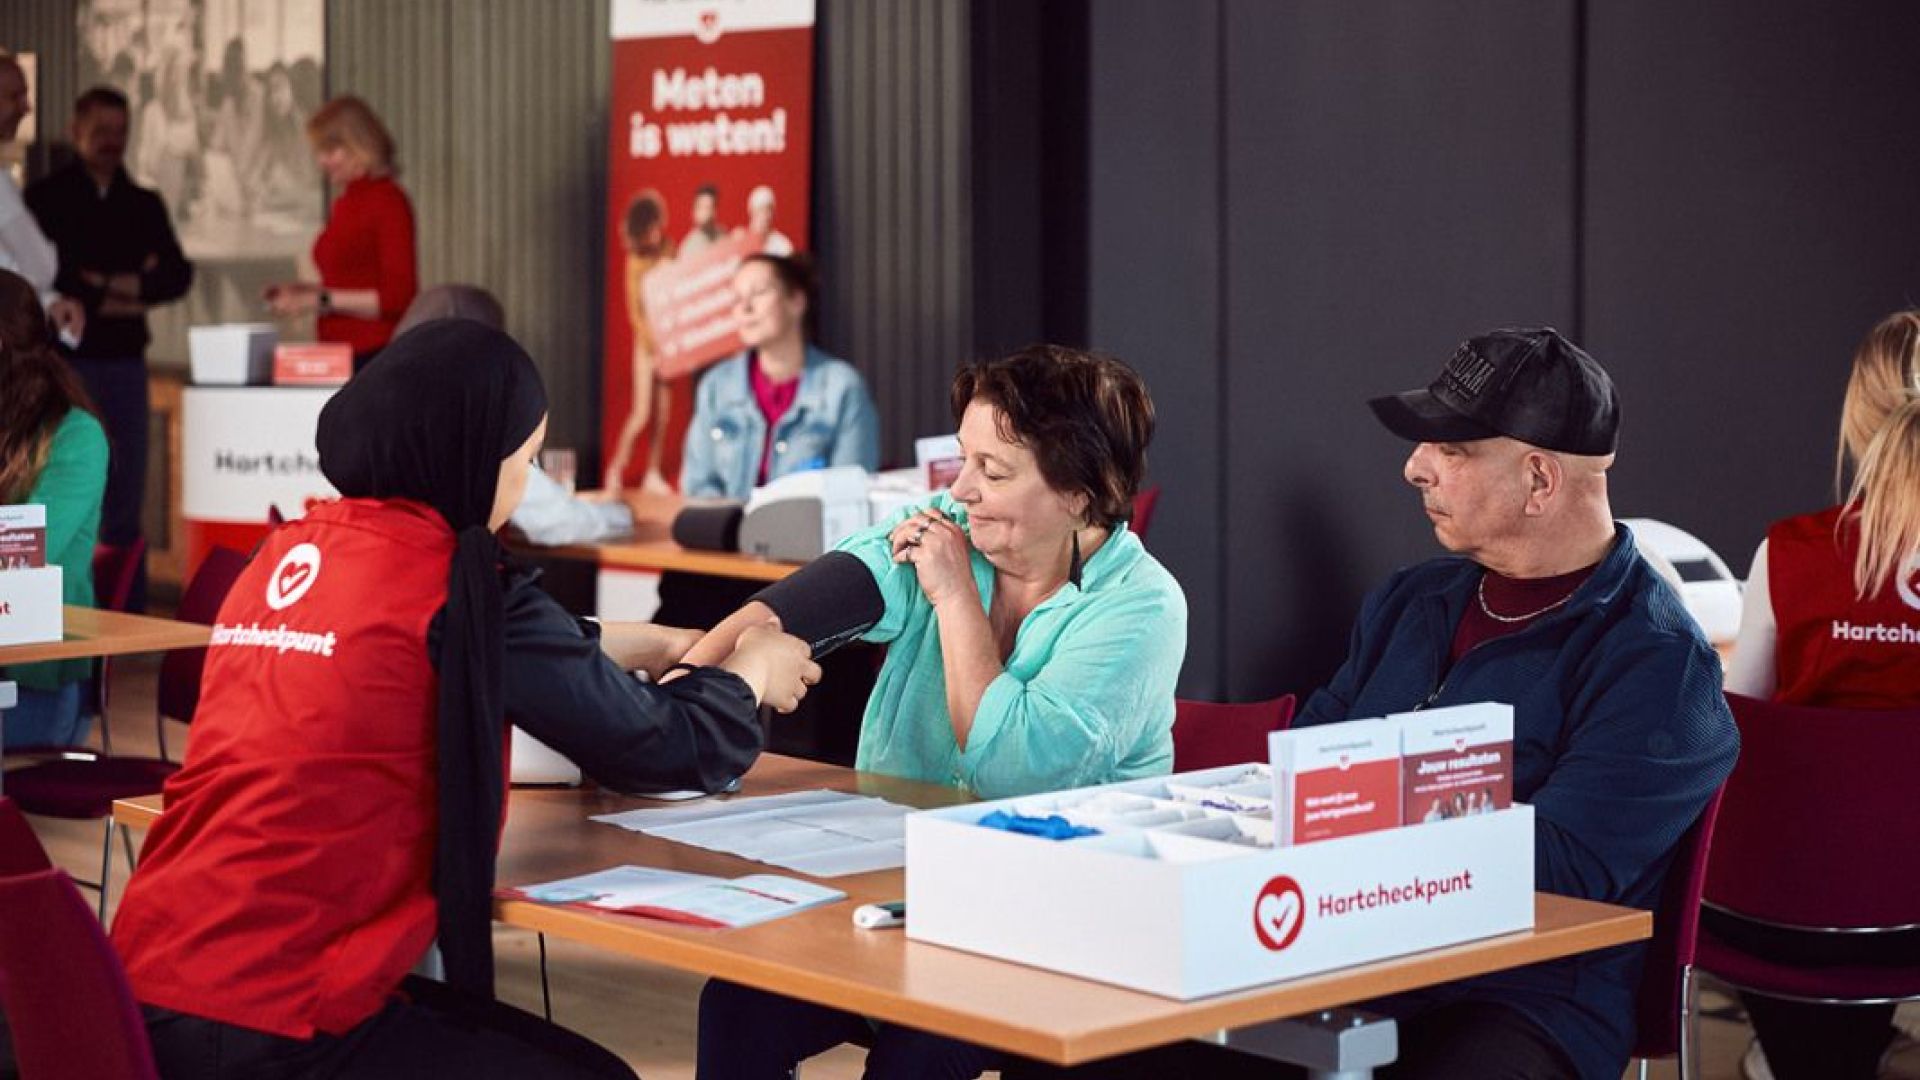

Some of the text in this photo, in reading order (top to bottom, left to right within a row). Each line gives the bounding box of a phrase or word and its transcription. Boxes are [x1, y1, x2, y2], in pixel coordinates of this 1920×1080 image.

[652, 66, 764, 112] Meten
[630, 107, 786, 157] is weten!
[215, 451, 320, 472] Hartch
[1318, 869, 1473, 918] Hartcheckpunt
